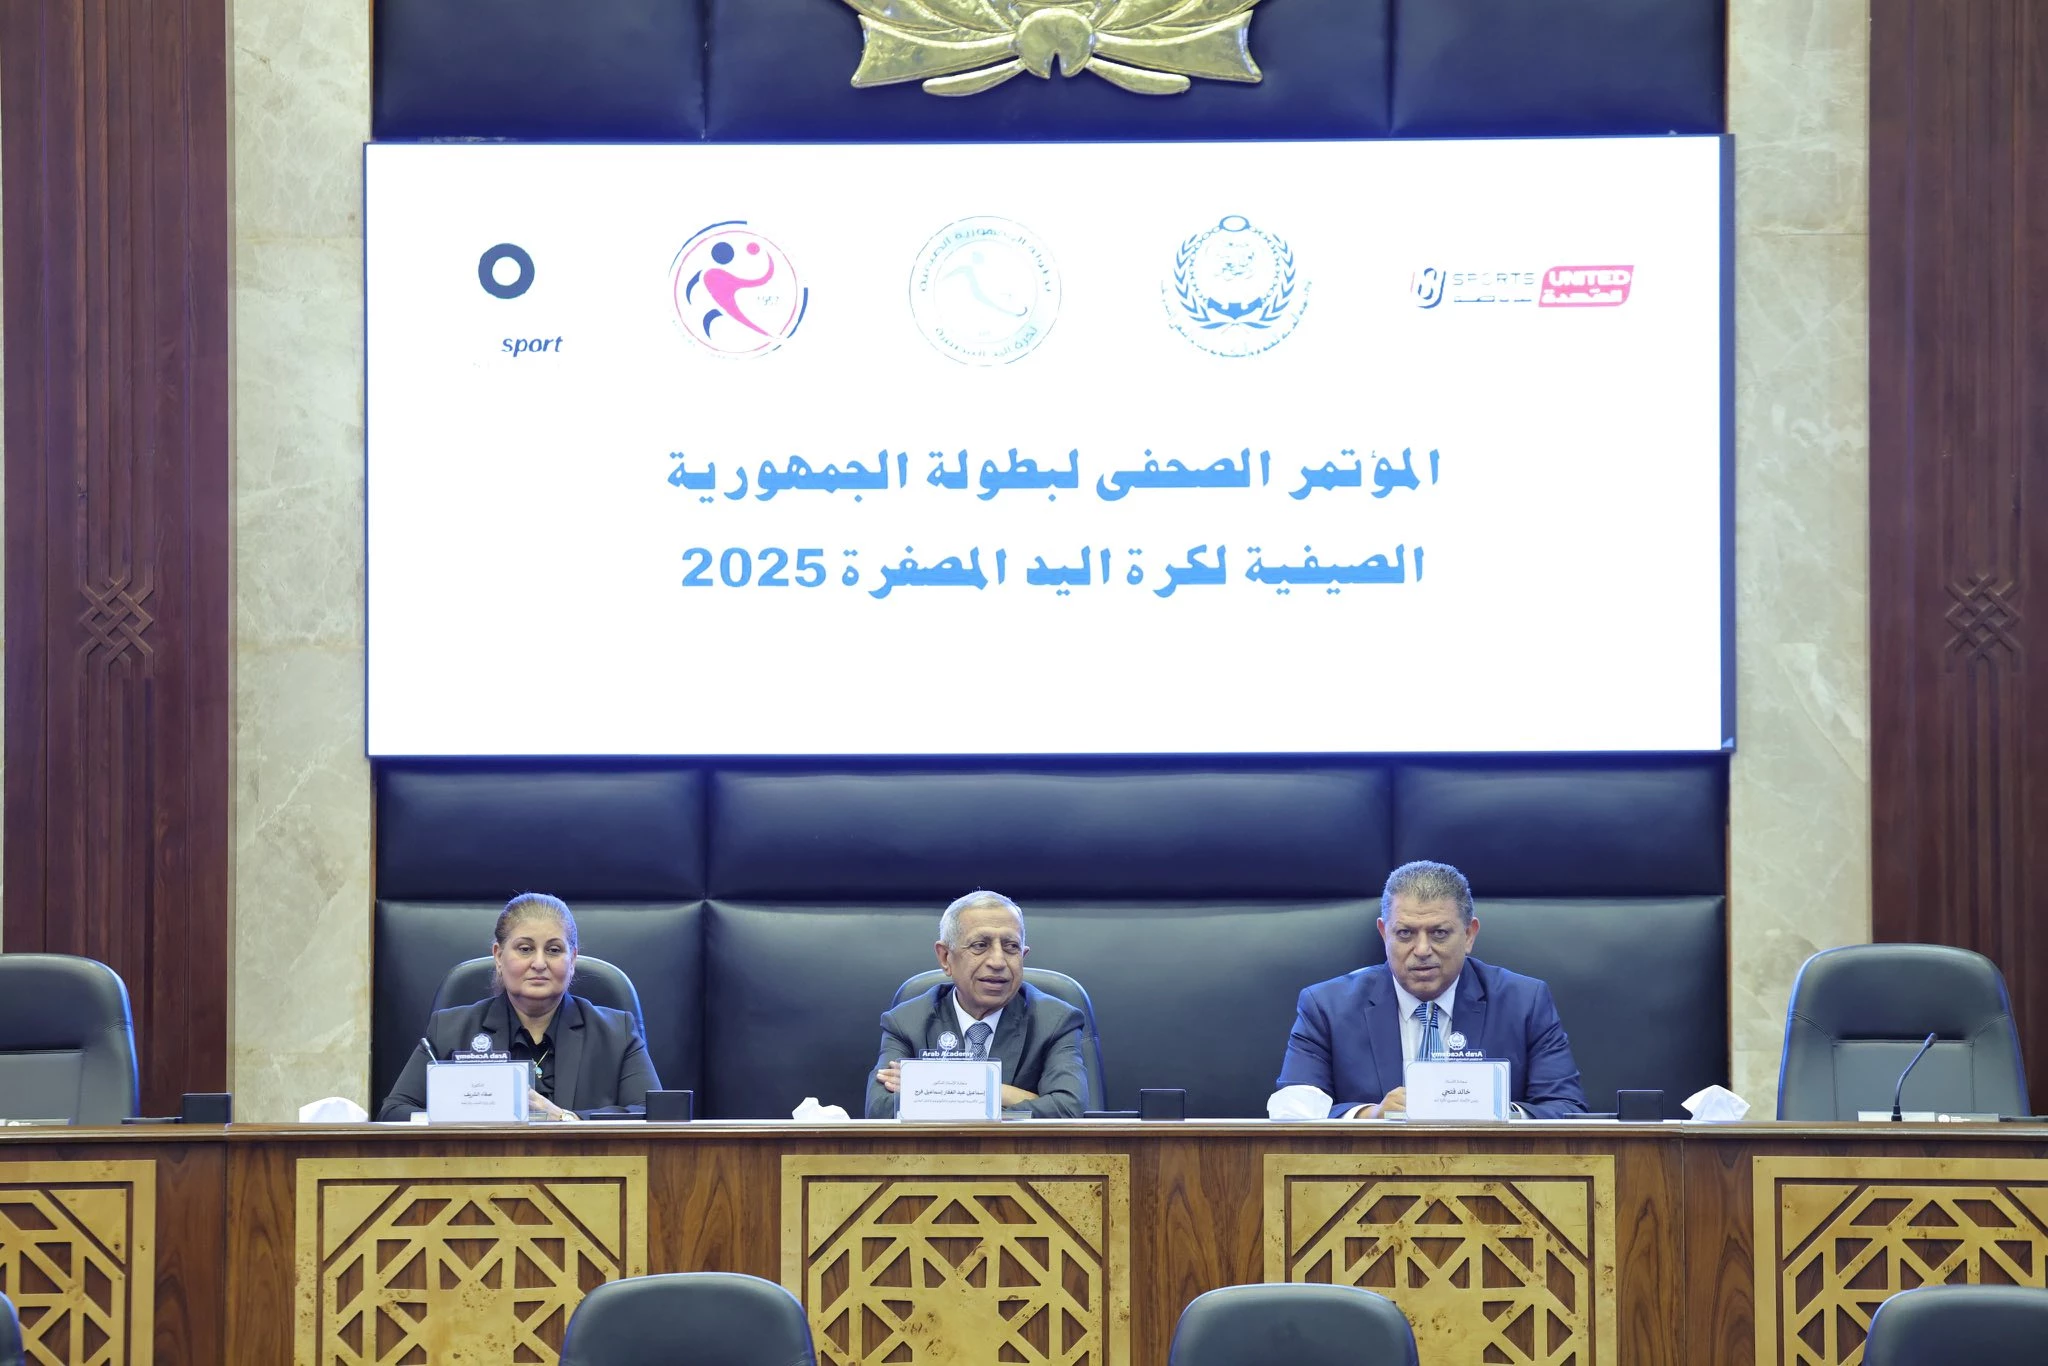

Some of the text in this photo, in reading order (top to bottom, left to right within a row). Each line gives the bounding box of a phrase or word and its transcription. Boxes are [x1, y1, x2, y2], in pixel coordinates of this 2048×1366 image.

[1549, 269, 1631, 287] UNITED
[501, 336, 563, 358] sport
[667, 448, 908, 504] الجمهورية
[927, 447, 1080, 502] لبطولة
[1288, 447, 1440, 501] المؤتمر
[682, 546, 827, 589] 2025
[1026, 545, 1112, 597] اليد
[1126, 544, 1228, 599] لكرة
[1244, 544, 1425, 596] الصيفية
[941, 1050, 974, 1058] Academy
